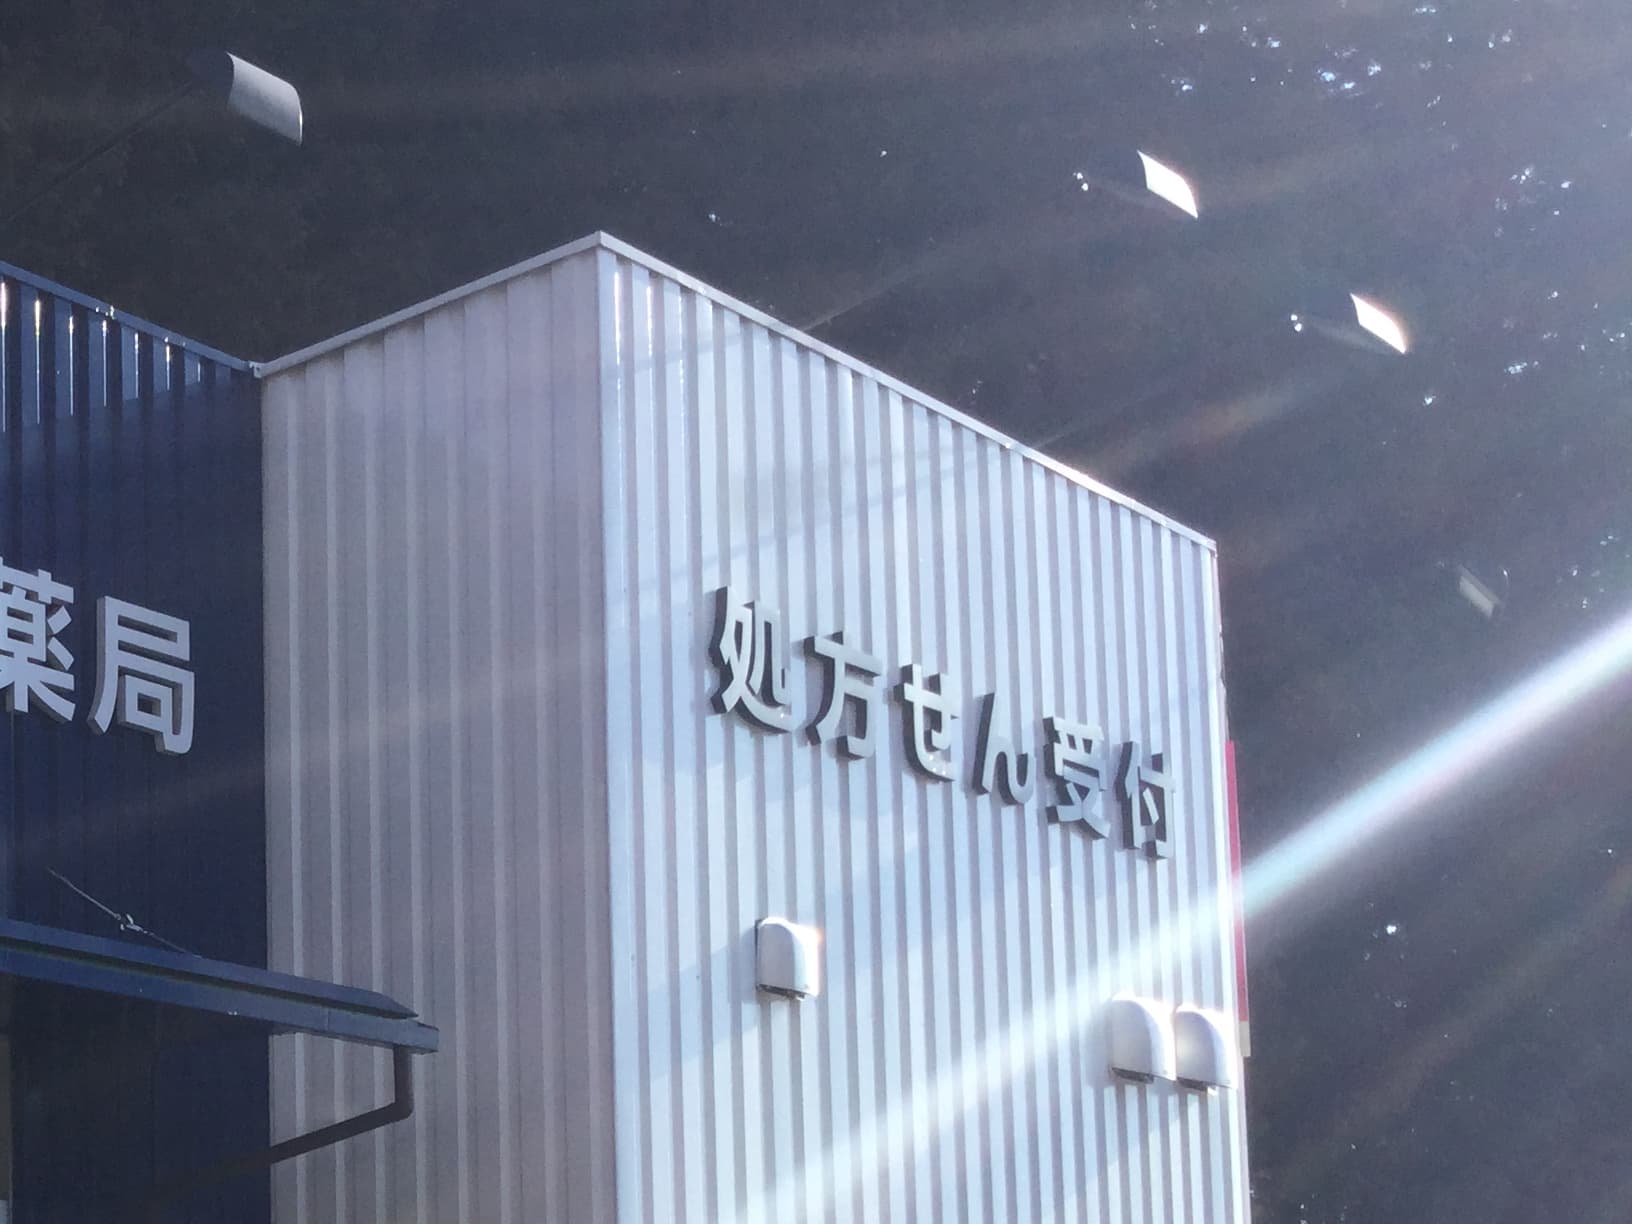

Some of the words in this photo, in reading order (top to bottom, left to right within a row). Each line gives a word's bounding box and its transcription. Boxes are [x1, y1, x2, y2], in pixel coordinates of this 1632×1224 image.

[708, 585, 1176, 860] 処方せん受付
